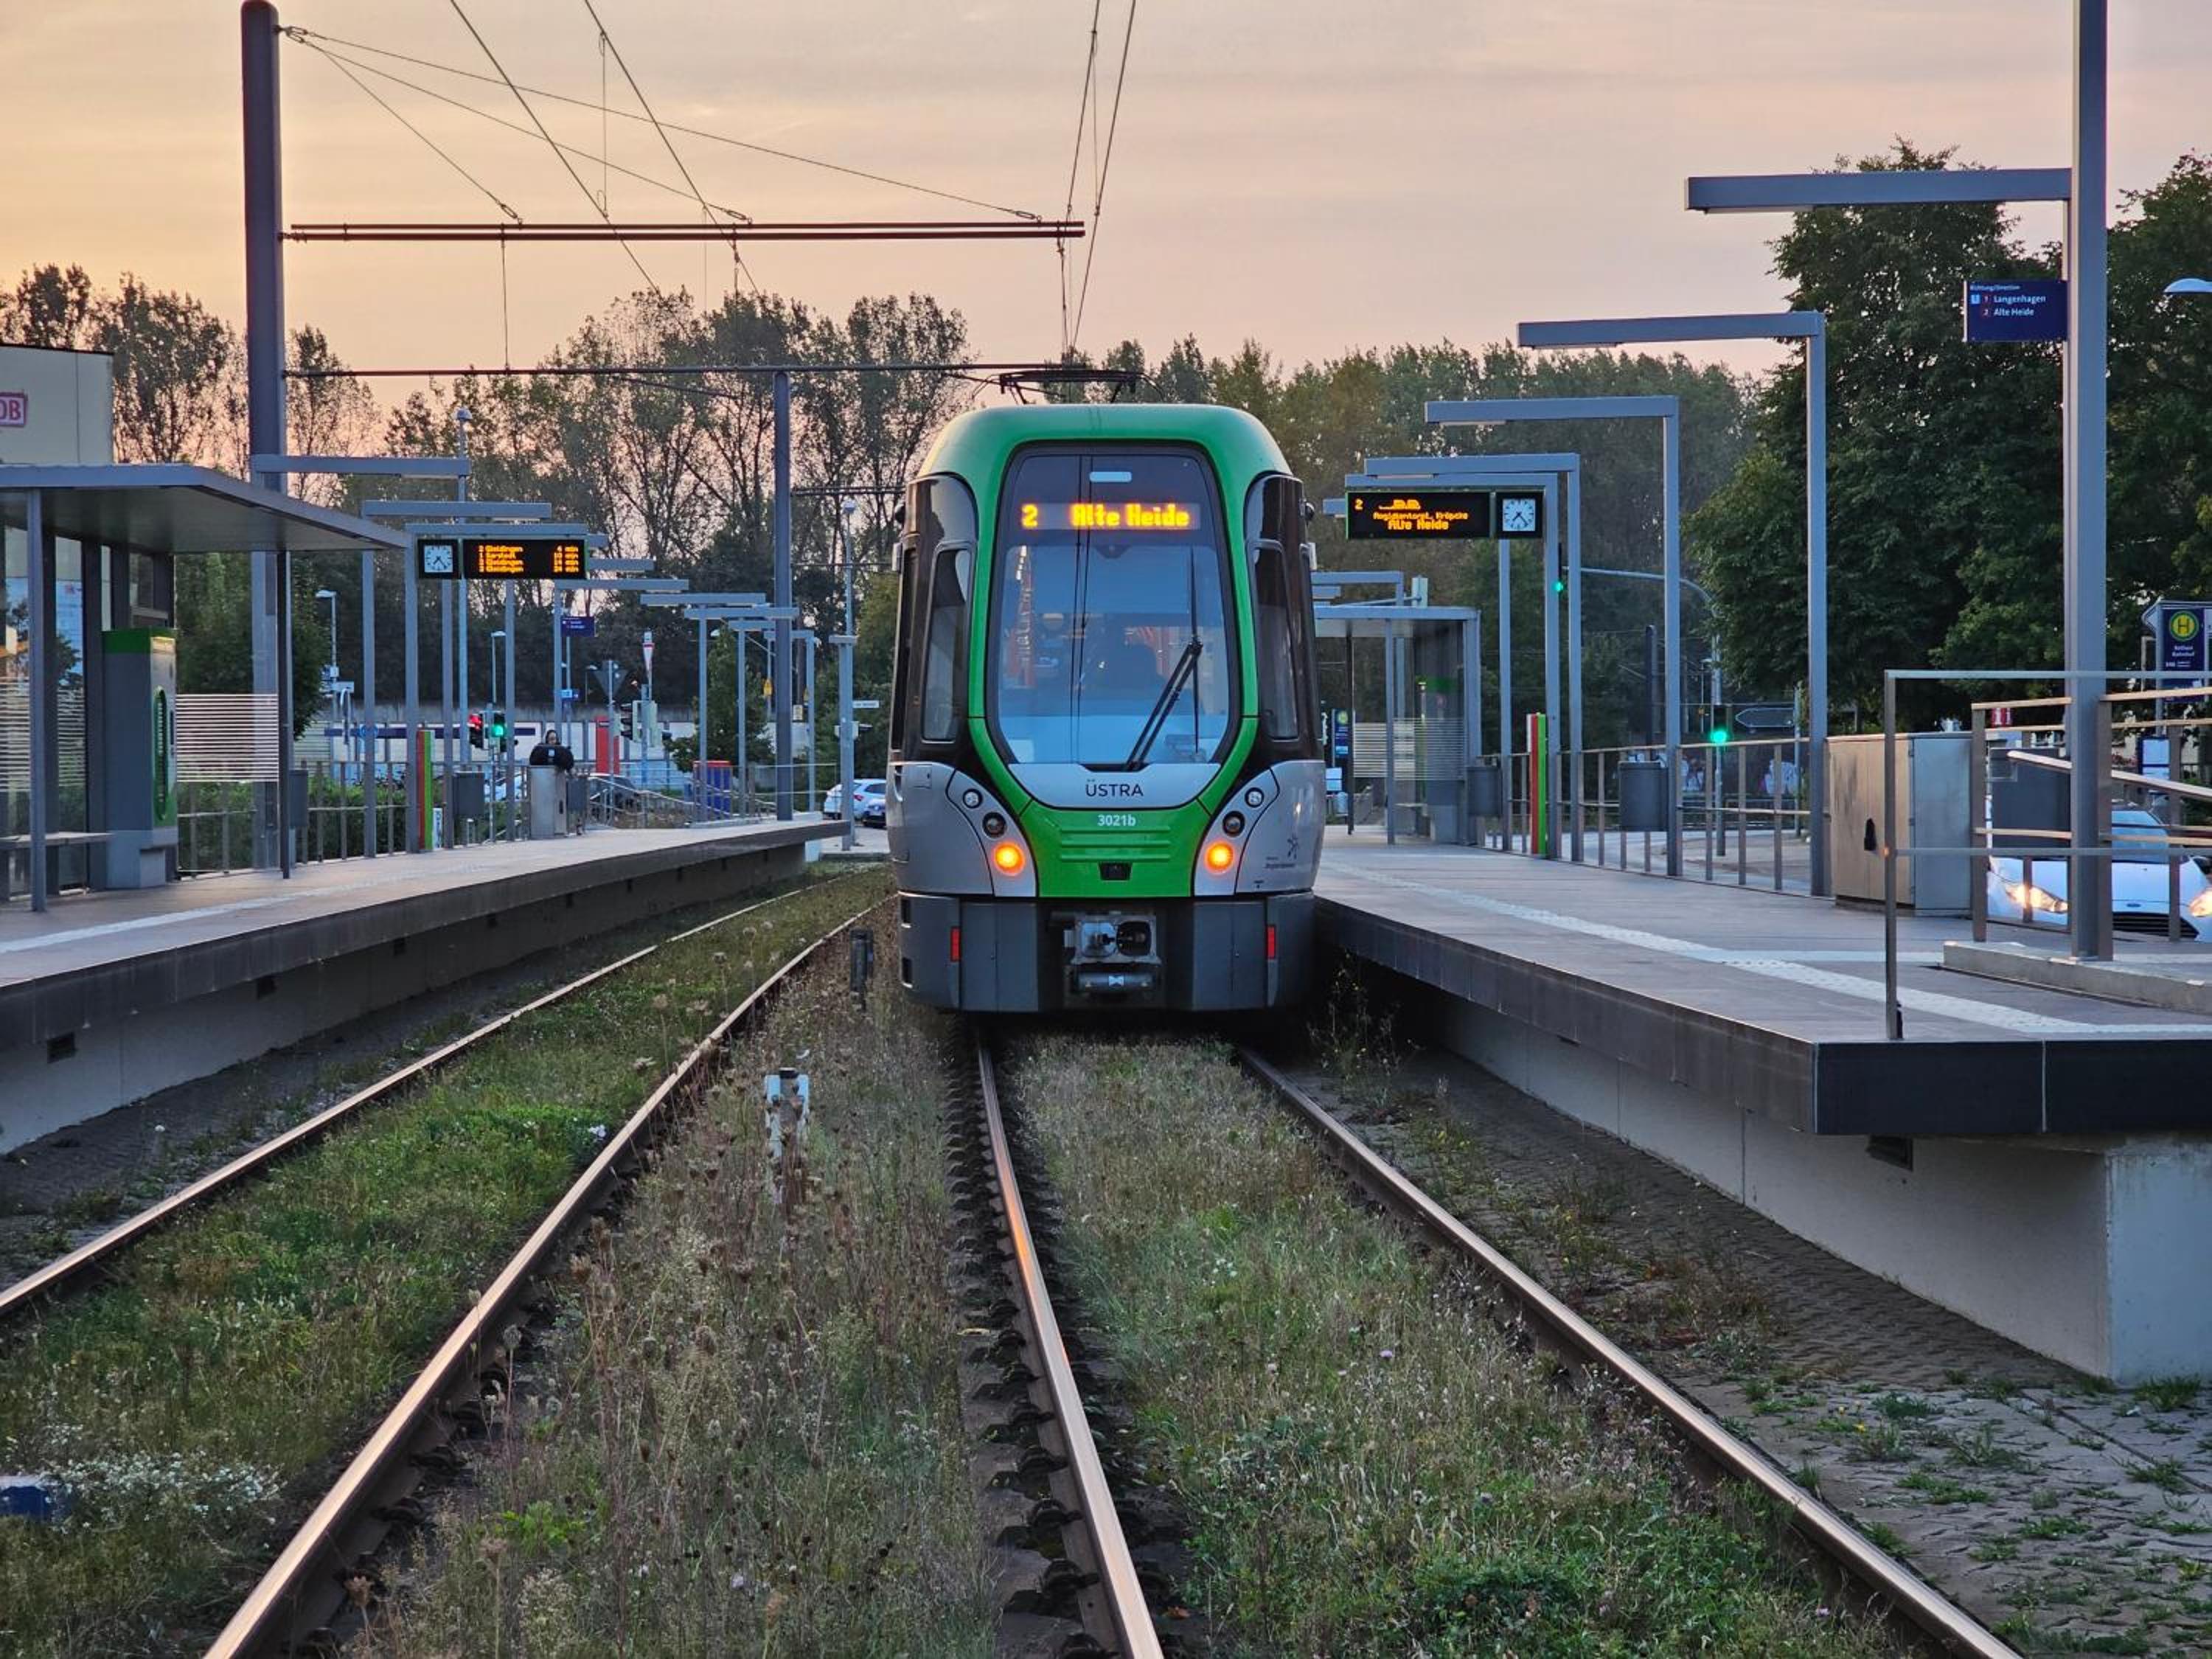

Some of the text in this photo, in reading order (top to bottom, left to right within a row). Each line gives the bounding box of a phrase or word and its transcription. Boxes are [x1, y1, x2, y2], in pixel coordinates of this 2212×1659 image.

[1993, 295, 2046, 305] Langenhagen
[1993, 307, 2010, 316] Alte
[2011, 307, 2034, 316] Heide
[1355, 499, 1363, 510] 2
[1021, 502, 1190, 528] 2 Alte Heide
[1086, 779, 1144, 797] ÜSTRA
[1097, 813, 1136, 827] 3021b
